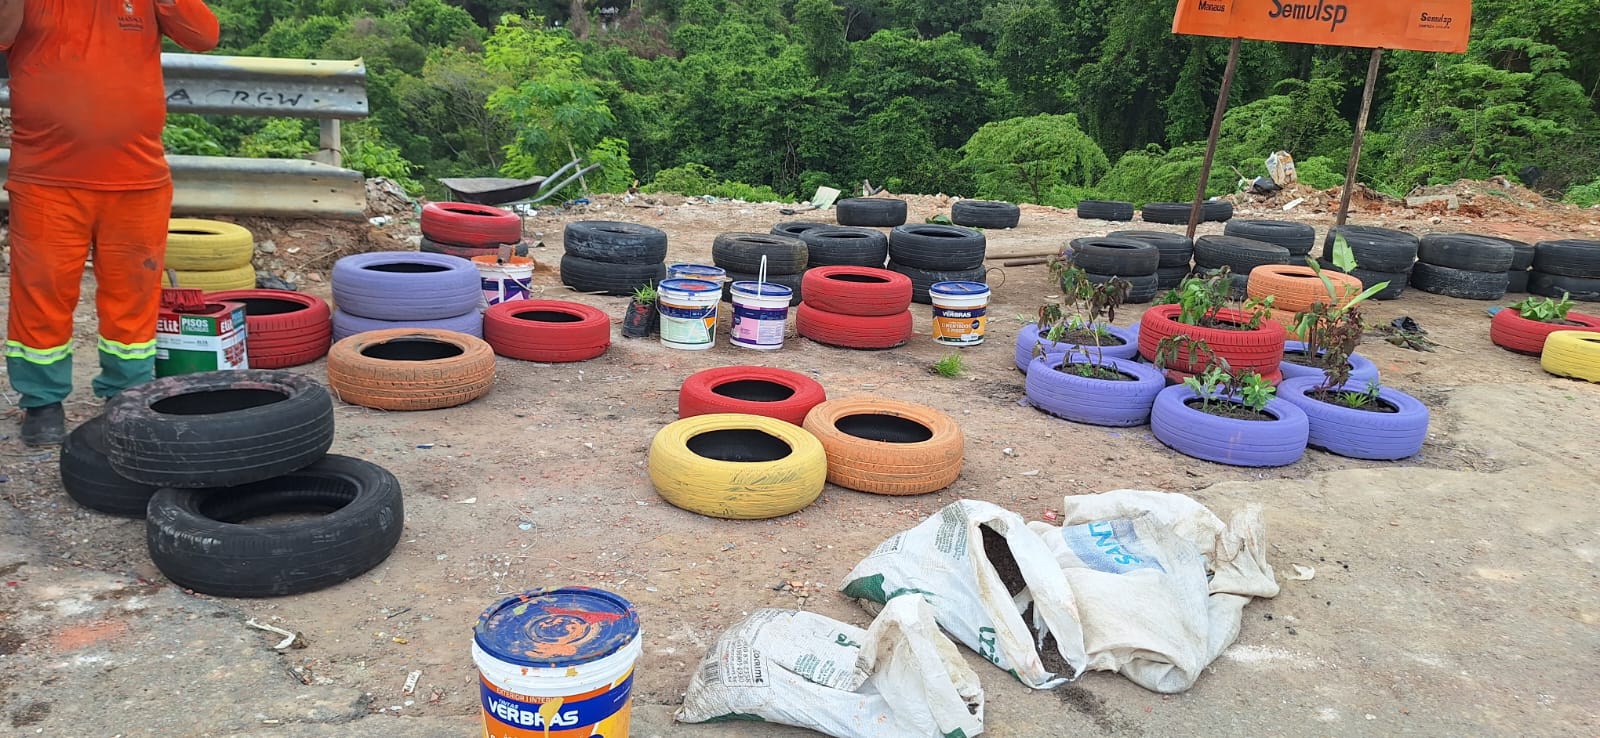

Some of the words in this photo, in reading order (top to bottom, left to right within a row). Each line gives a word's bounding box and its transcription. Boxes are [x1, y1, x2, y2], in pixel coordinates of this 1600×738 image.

[1198, 0, 1226, 12] Manaus
[1268, 0, 1348, 32] Semulsp
[181, 317, 209, 328] PISOS
[487, 695, 579, 727] VERBRAS
